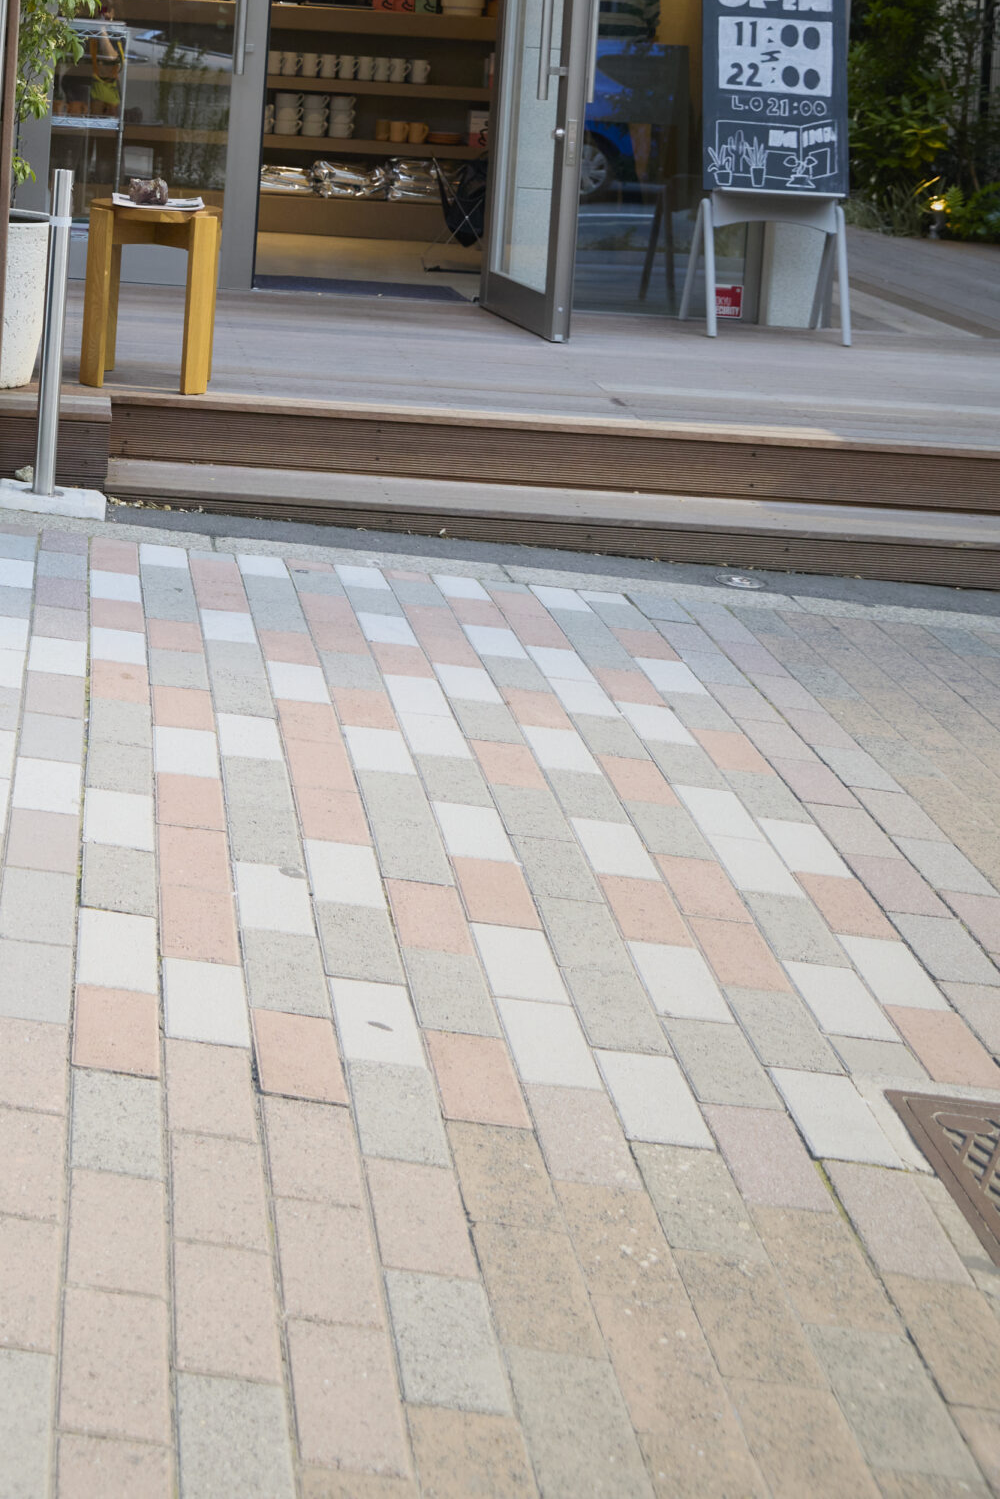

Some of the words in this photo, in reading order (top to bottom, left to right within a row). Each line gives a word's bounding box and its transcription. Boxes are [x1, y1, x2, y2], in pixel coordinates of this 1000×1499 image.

[734, 21, 820, 50] 11:00
[726, 62, 820, 90] 22:00
[766, 98, 827, 117] 21:00
[715, 306, 740, 317] ECURITY
